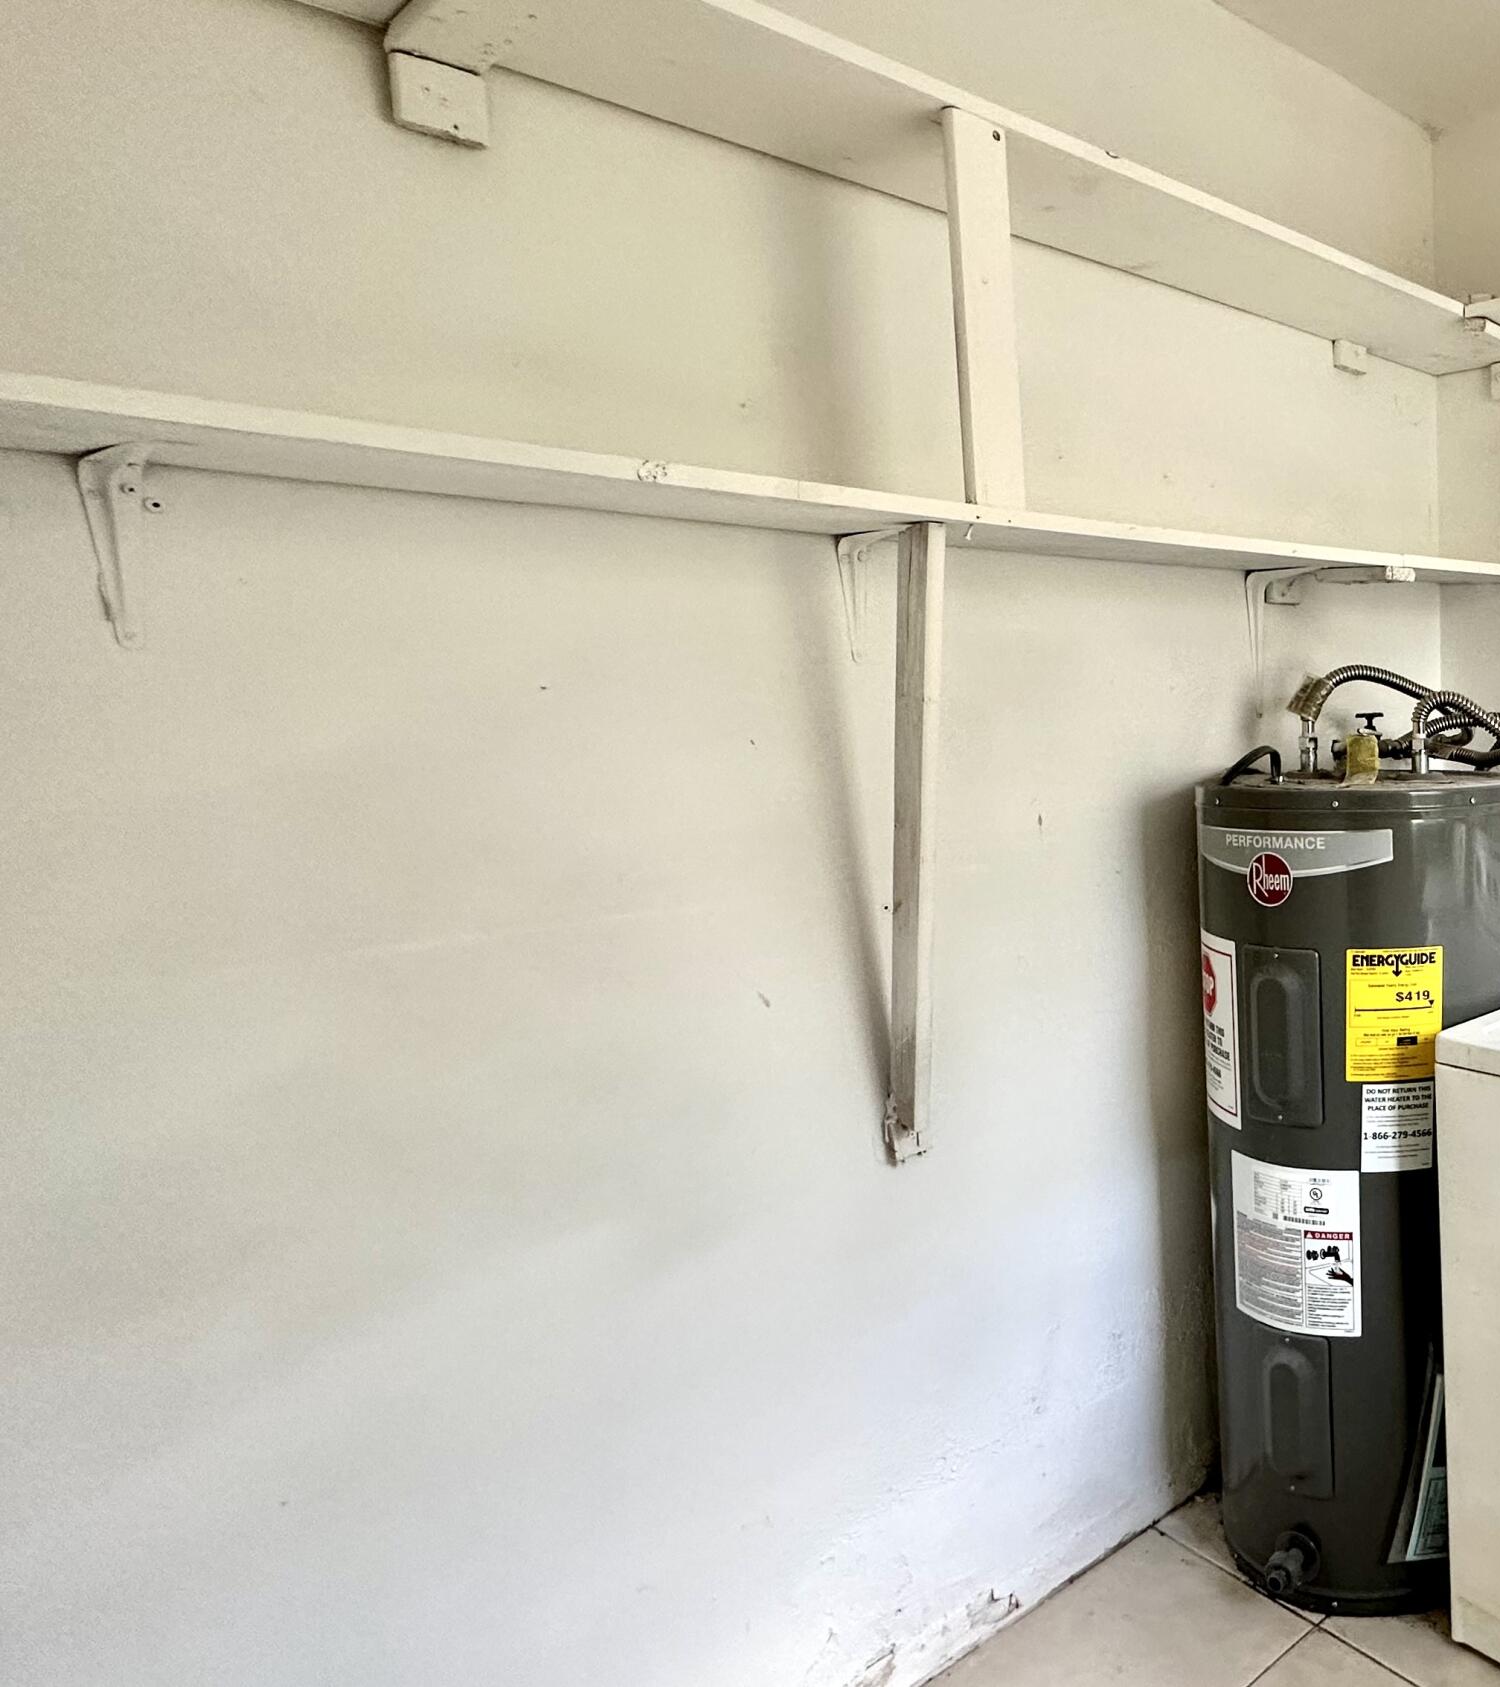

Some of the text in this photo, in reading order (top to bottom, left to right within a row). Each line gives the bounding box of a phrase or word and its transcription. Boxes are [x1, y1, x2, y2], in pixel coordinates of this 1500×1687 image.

[1226, 833, 1326, 850] PERFORMANCE
[1252, 854, 1290, 897] Rheem
[1352, 952, 1436, 971] ENERGYGUIDE
[1395, 989, 1430, 1003] $419
[1392, 1086, 1417, 1094] RETURN
[1387, 1095, 1411, 1103] HEATER
[1397, 1102, 1429, 1111] PURCHASE
[1363, 1128, 1432, 1140] 1-866-279-4566
[1314, 1232, 1351, 1240] DANGER
